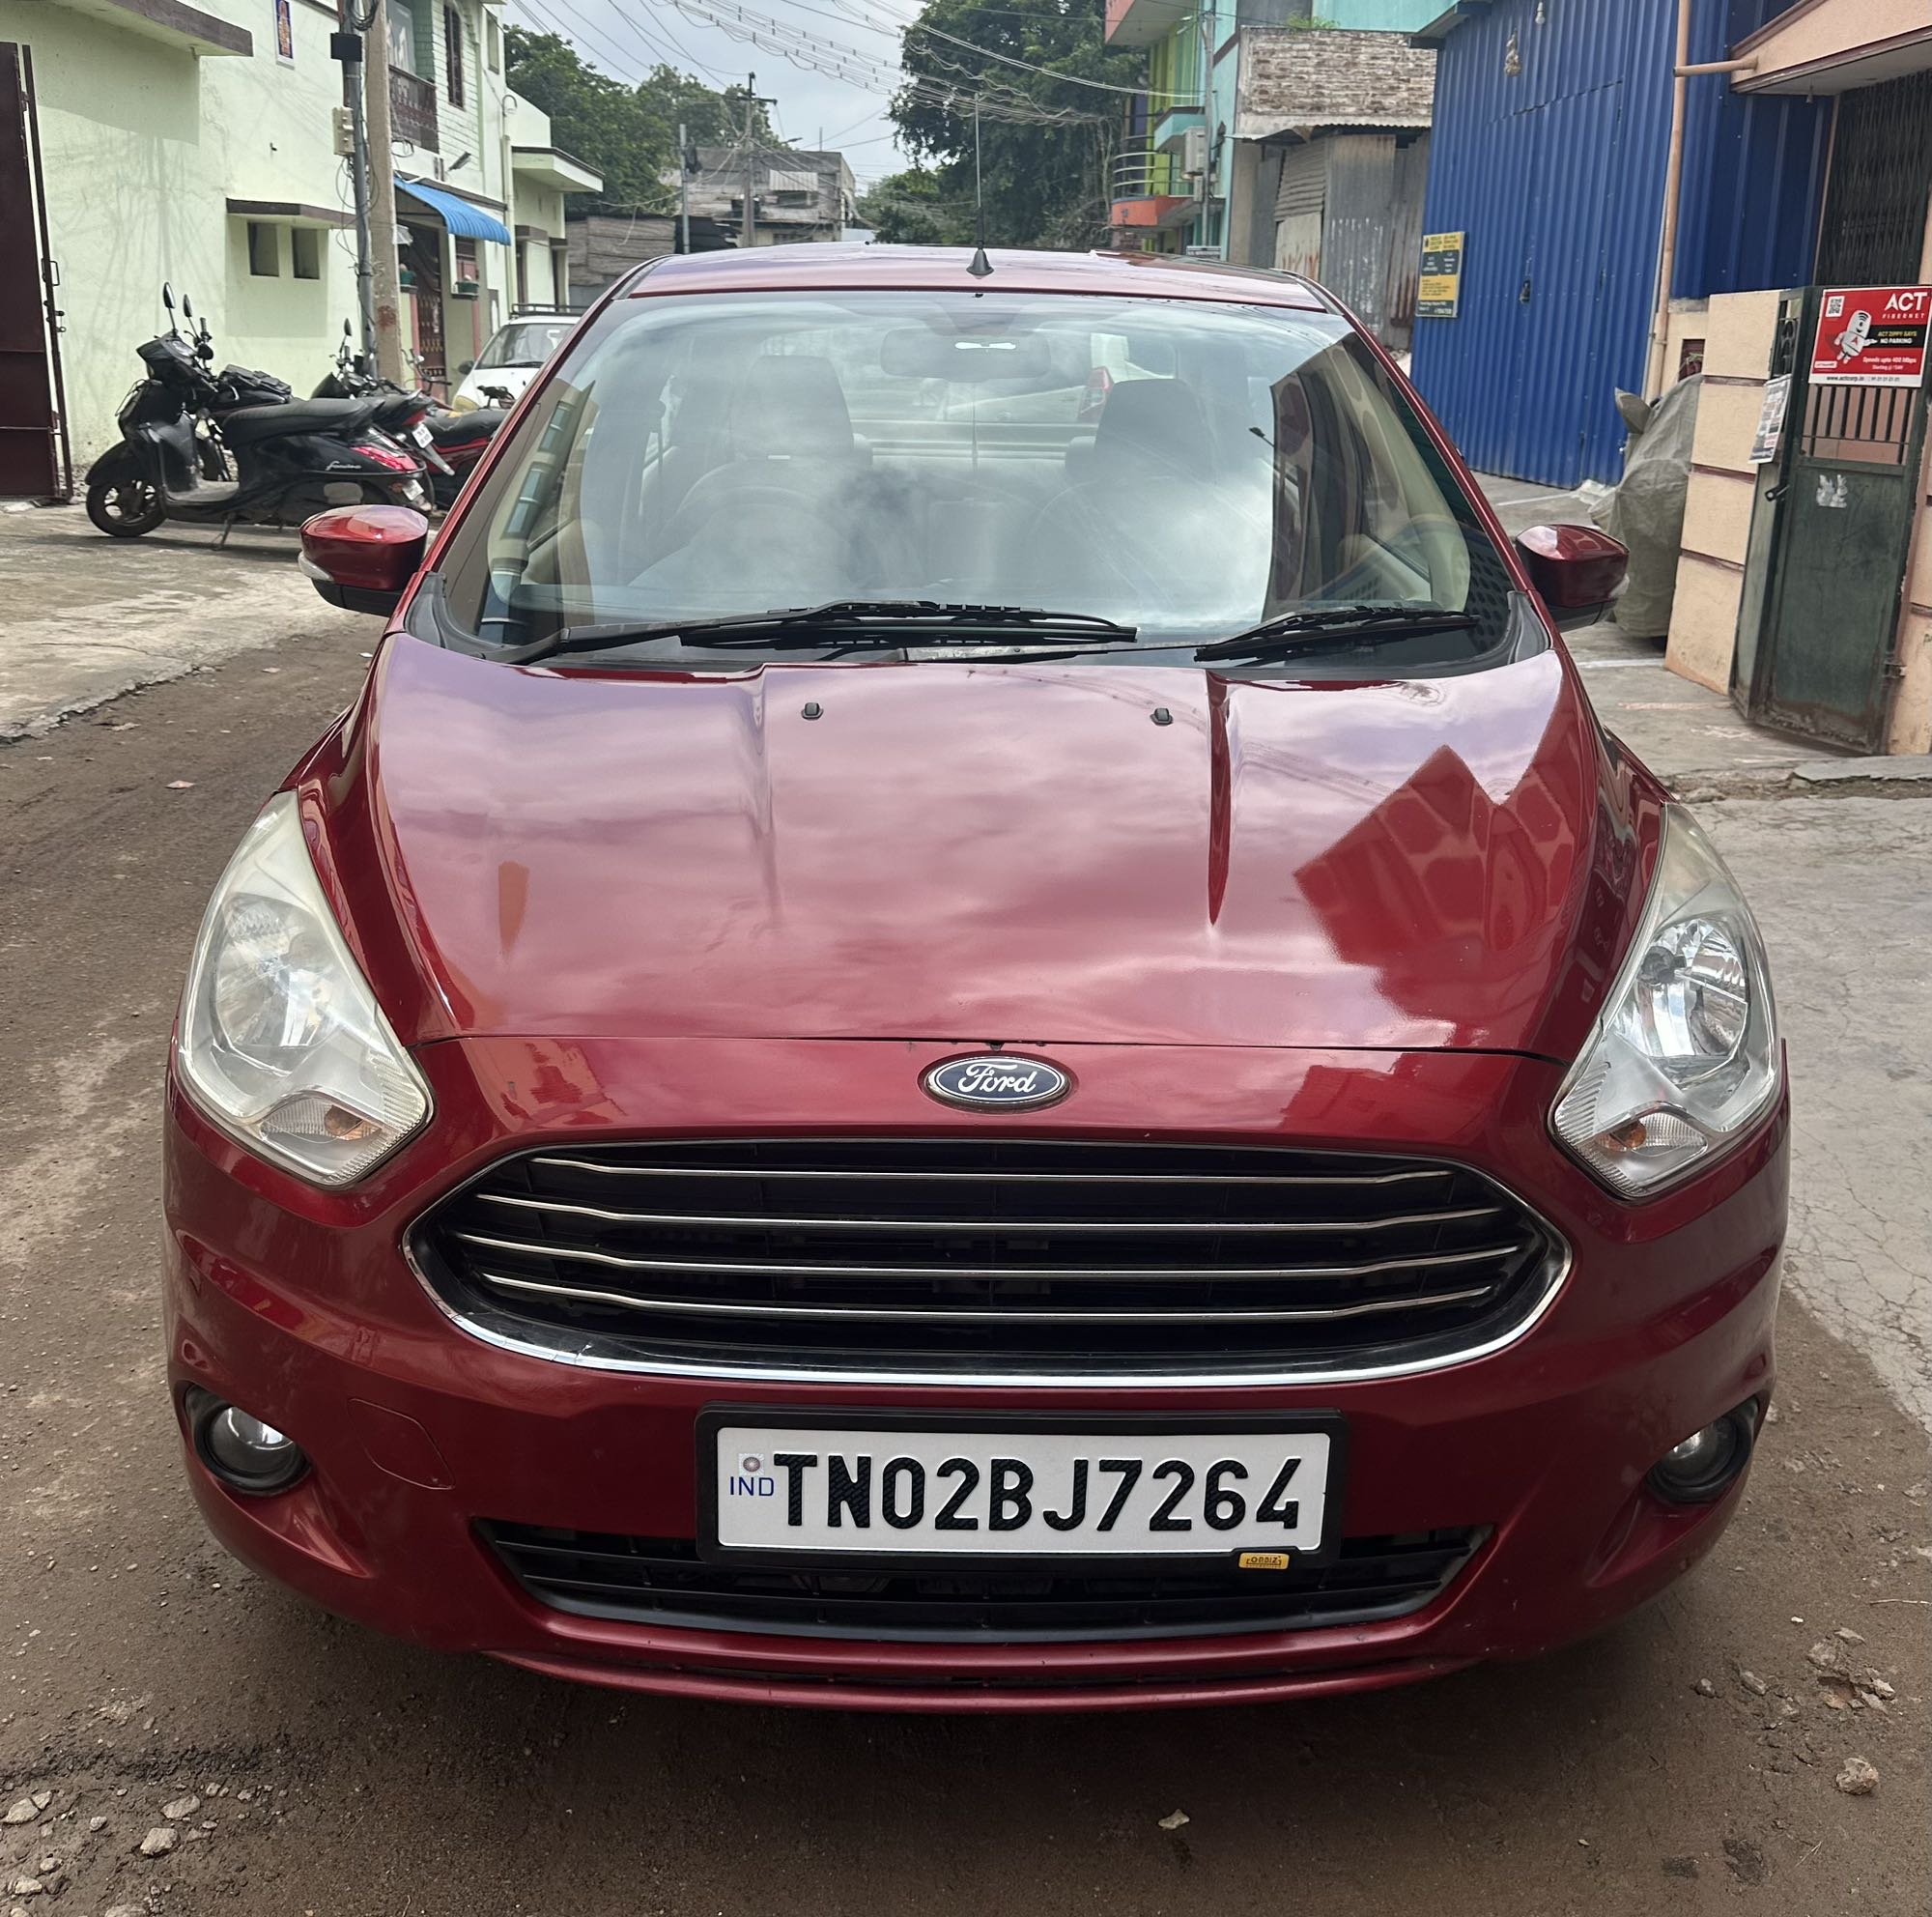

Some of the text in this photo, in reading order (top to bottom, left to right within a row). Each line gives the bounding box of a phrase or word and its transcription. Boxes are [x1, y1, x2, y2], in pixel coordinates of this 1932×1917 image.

[1885, 292, 1928, 311] ACT
[958, 1064, 1037, 1093] Ford
[729, 1475, 775, 1497] IND
[774, 1453, 1302, 1531] TN02BJ7264
